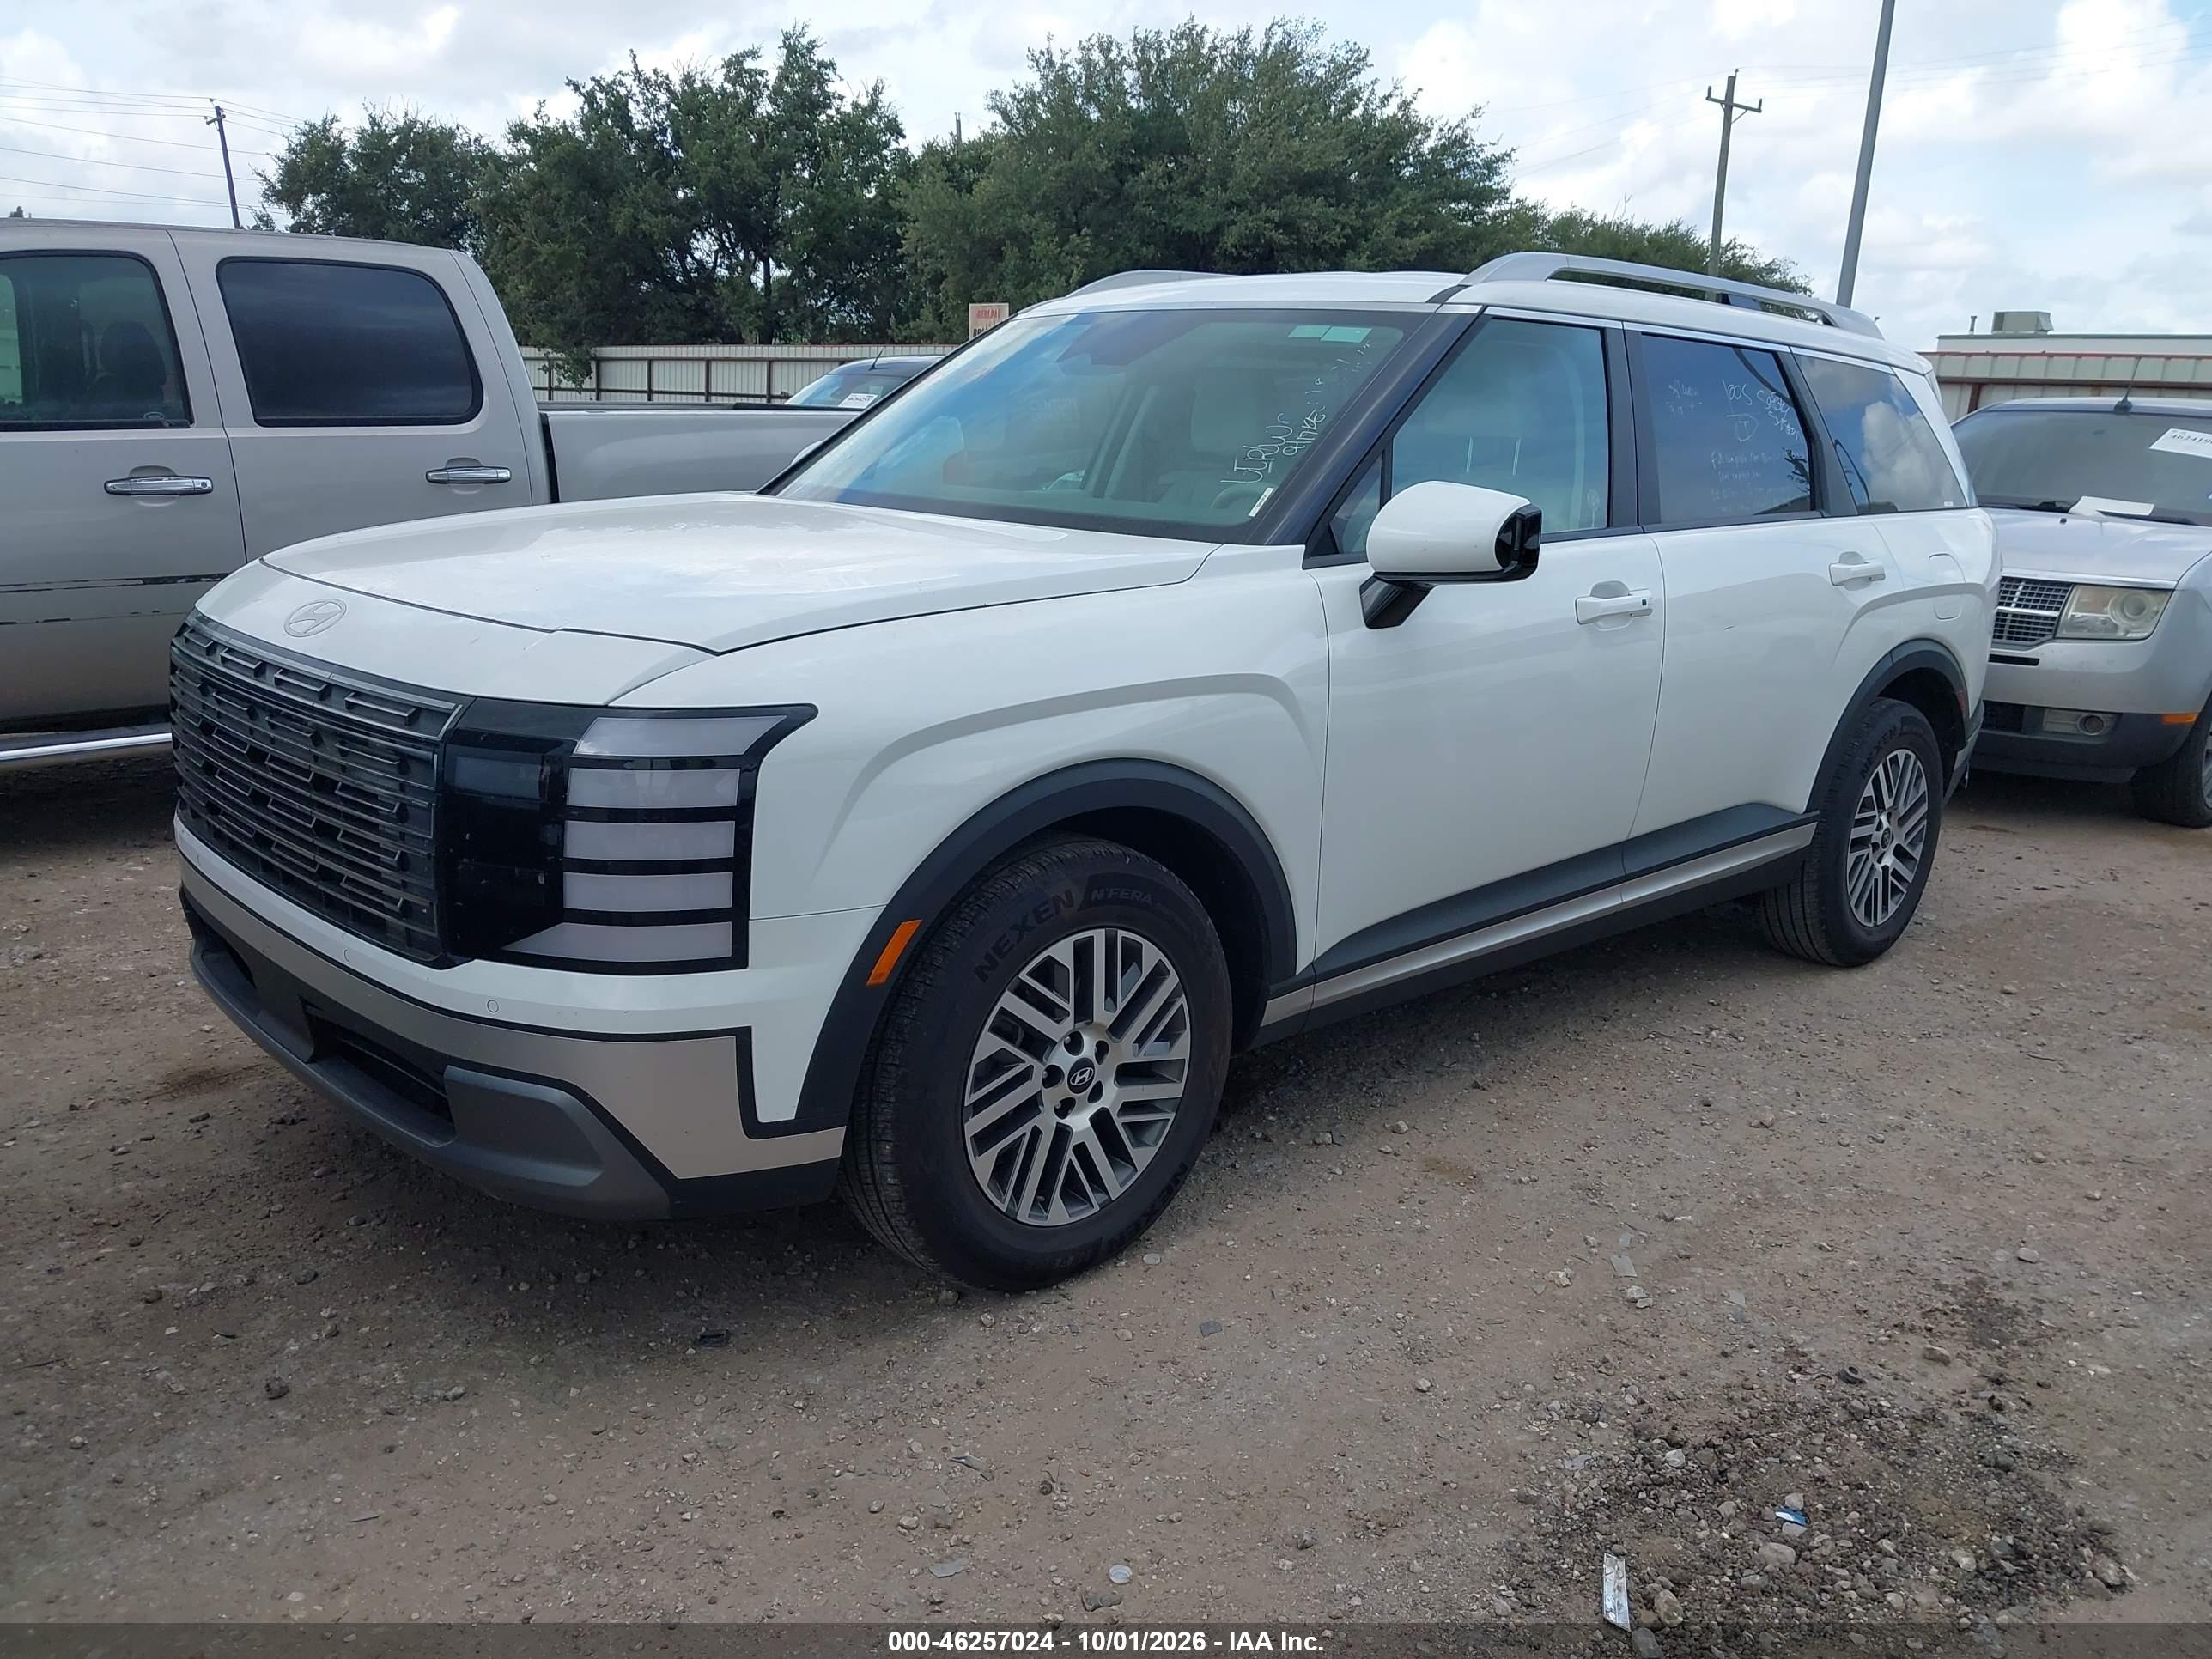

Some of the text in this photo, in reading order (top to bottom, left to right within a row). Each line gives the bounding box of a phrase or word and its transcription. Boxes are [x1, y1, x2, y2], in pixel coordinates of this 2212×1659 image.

[2172, 433, 2212, 445] 462419
[1091, 887, 1152, 906] N'FERA
[974, 890, 1074, 983] NEXEN
